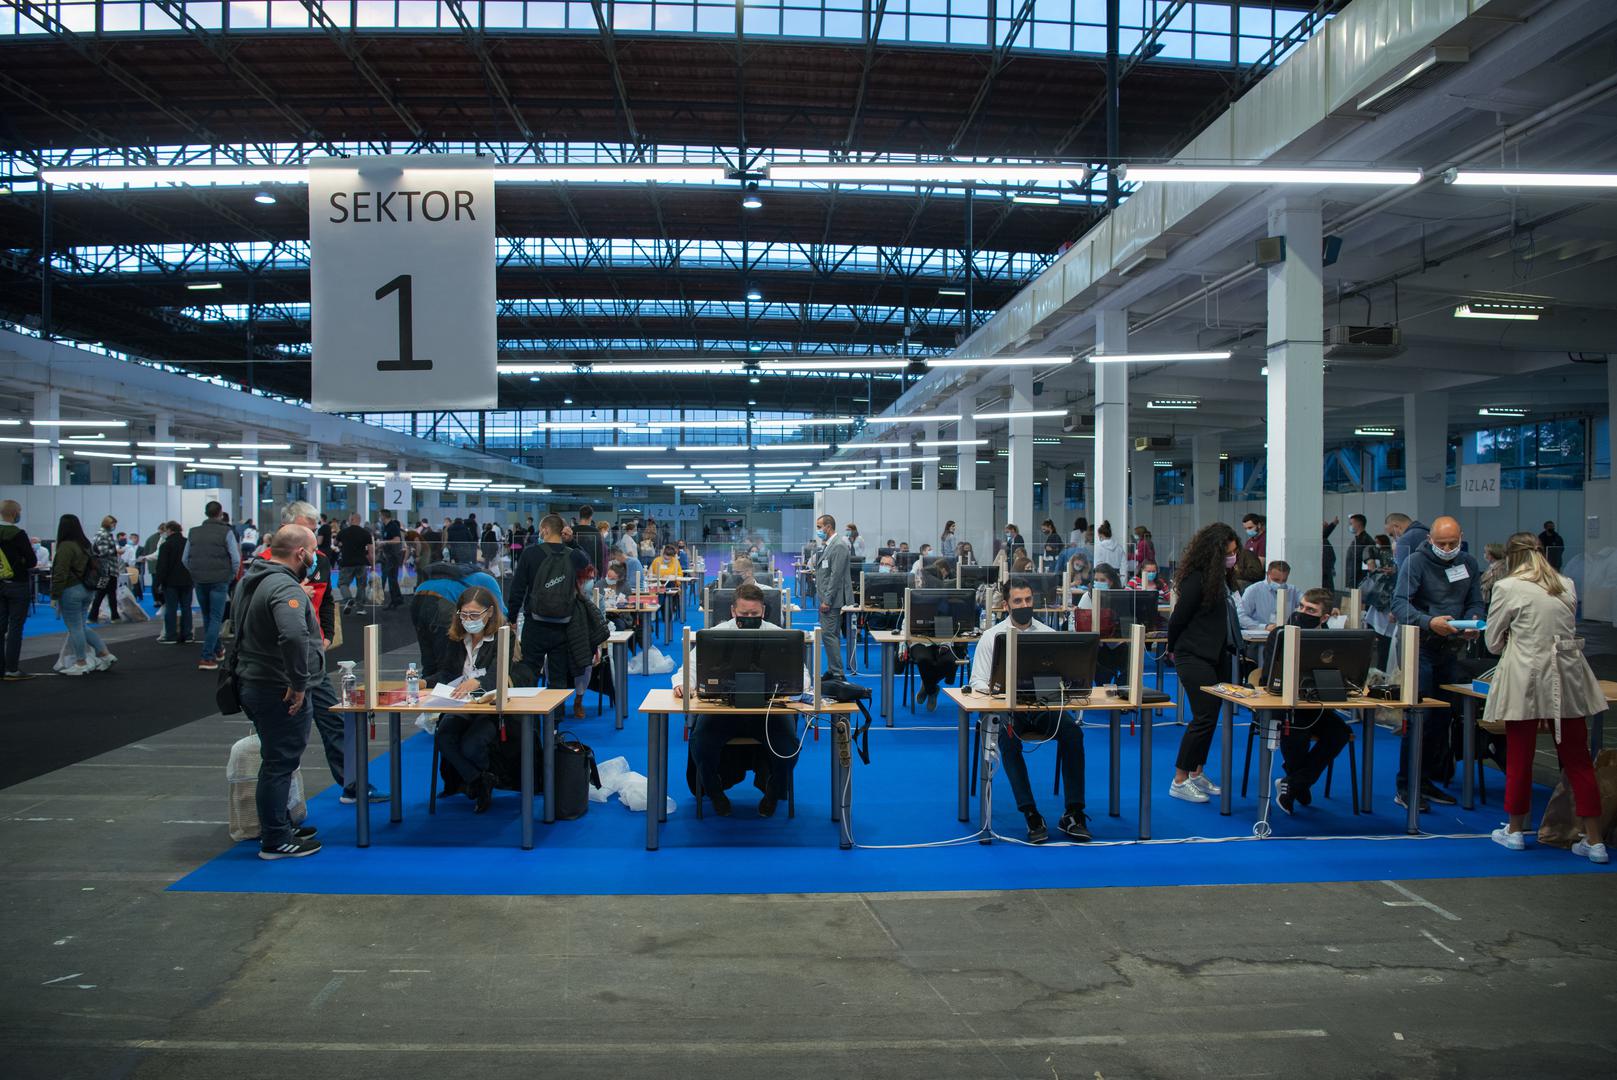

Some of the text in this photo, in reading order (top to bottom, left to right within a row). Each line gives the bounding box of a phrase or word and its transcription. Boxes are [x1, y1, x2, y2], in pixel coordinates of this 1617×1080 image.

[329, 190, 476, 224] SEKTOR
[375, 274, 433, 371] 1
[393, 489, 403, 504] 2
[1464, 479, 1496, 492] IZLAZ
